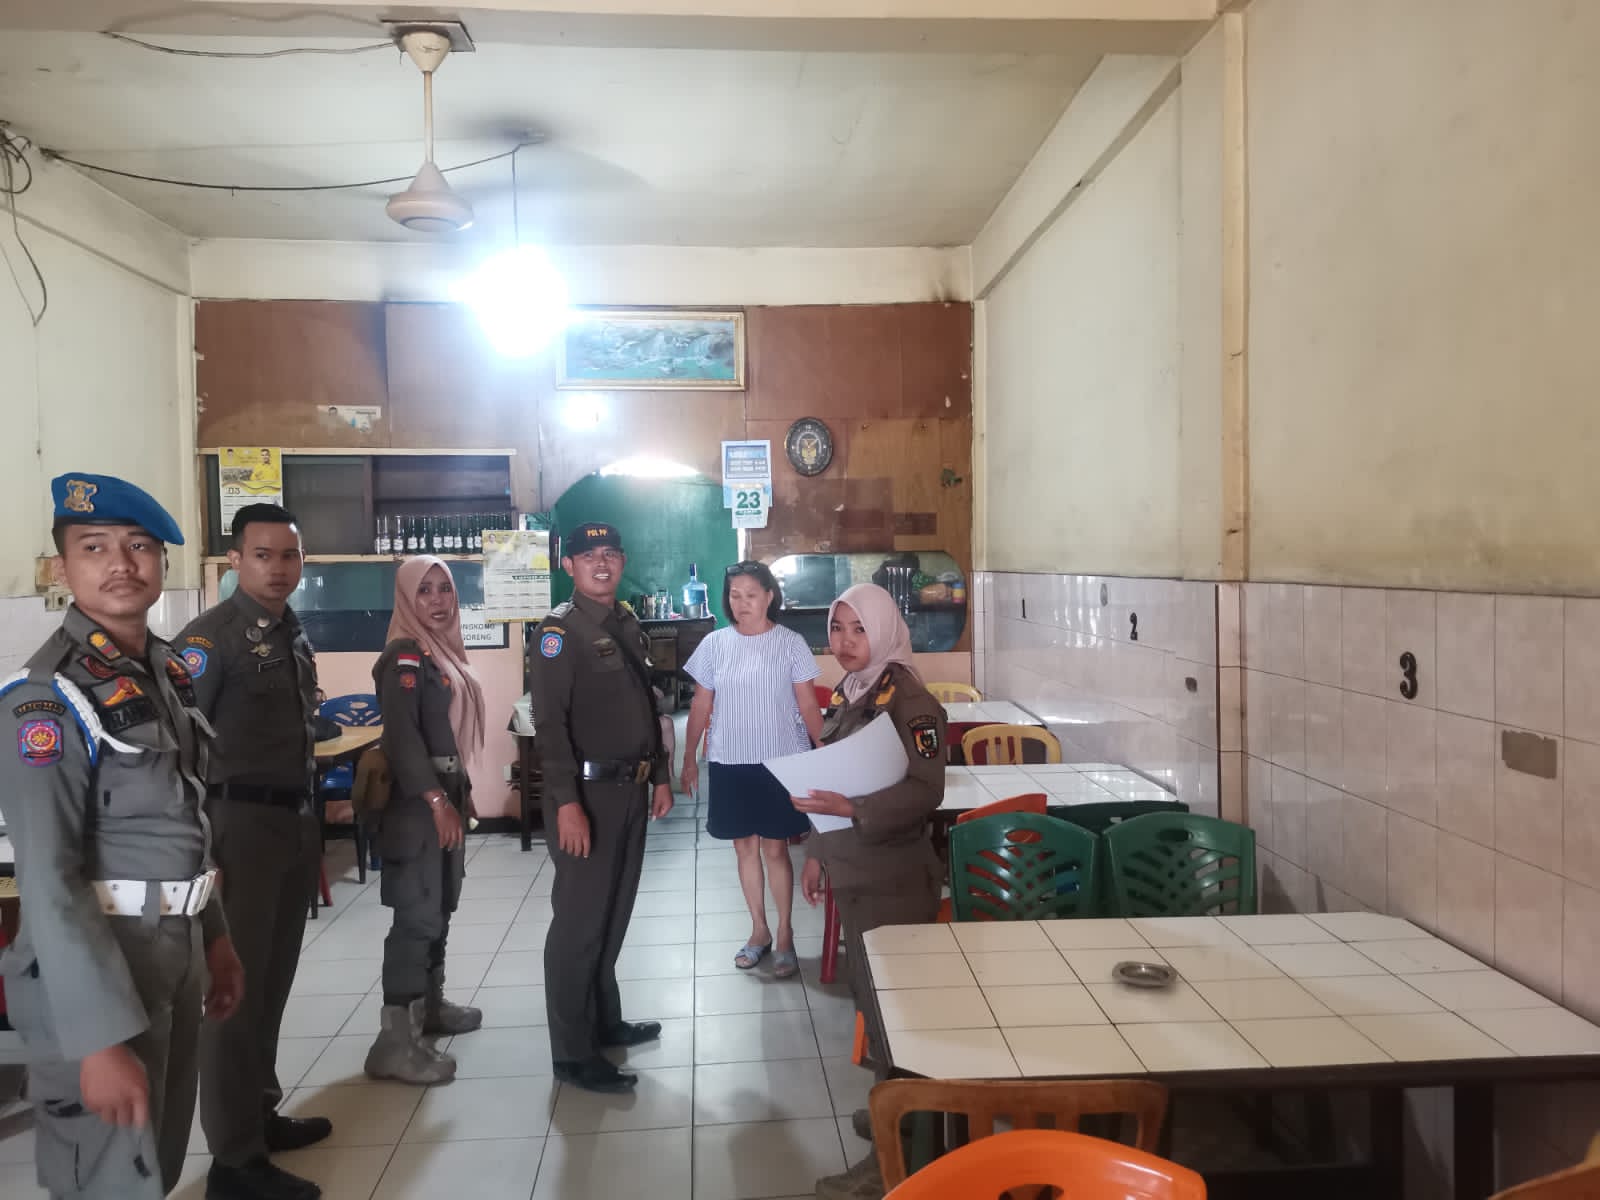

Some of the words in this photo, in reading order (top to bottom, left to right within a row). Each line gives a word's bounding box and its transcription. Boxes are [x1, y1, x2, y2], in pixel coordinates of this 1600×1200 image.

[737, 491, 761, 509] 23
[1129, 612, 1138, 641] 2
[1399, 651, 1418, 700] 3
